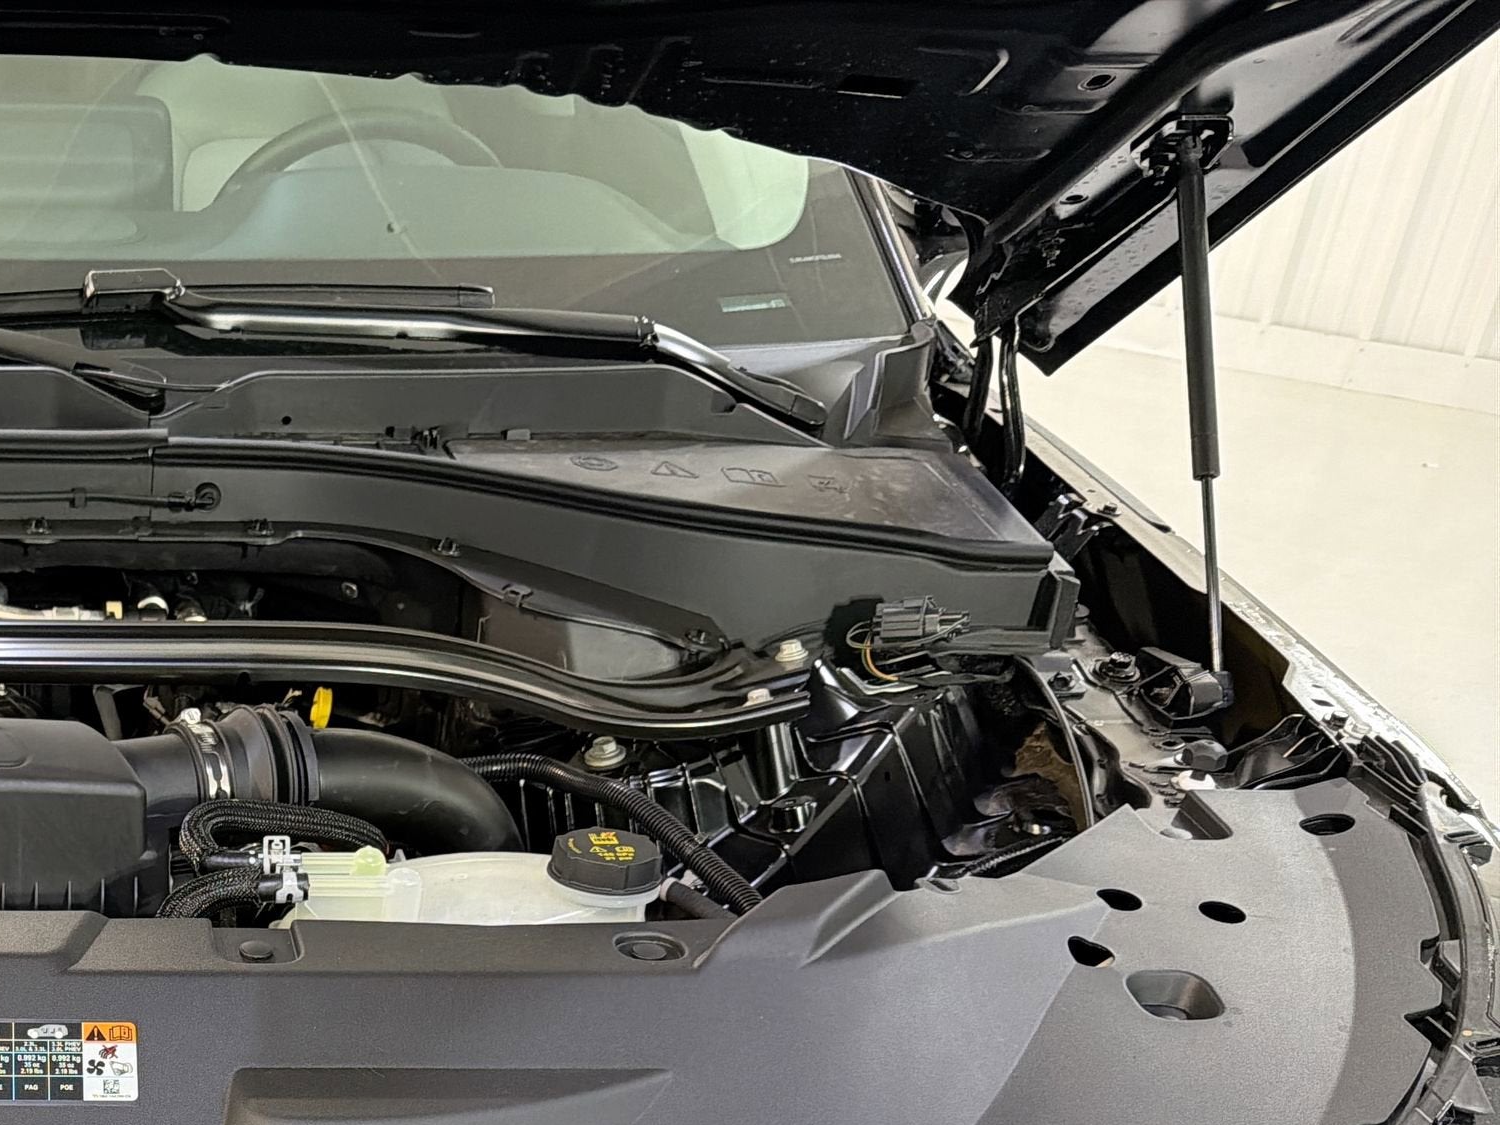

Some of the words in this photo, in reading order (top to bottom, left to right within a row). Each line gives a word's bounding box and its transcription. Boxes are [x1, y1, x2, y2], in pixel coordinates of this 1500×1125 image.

[0, 1054, 10, 1063] kg
[17, 1054, 37, 1062] 0.992
[38, 1054, 47, 1063] kg
[51, 1054, 71, 1062] 0.992
[72, 1054, 81, 1063] kg
